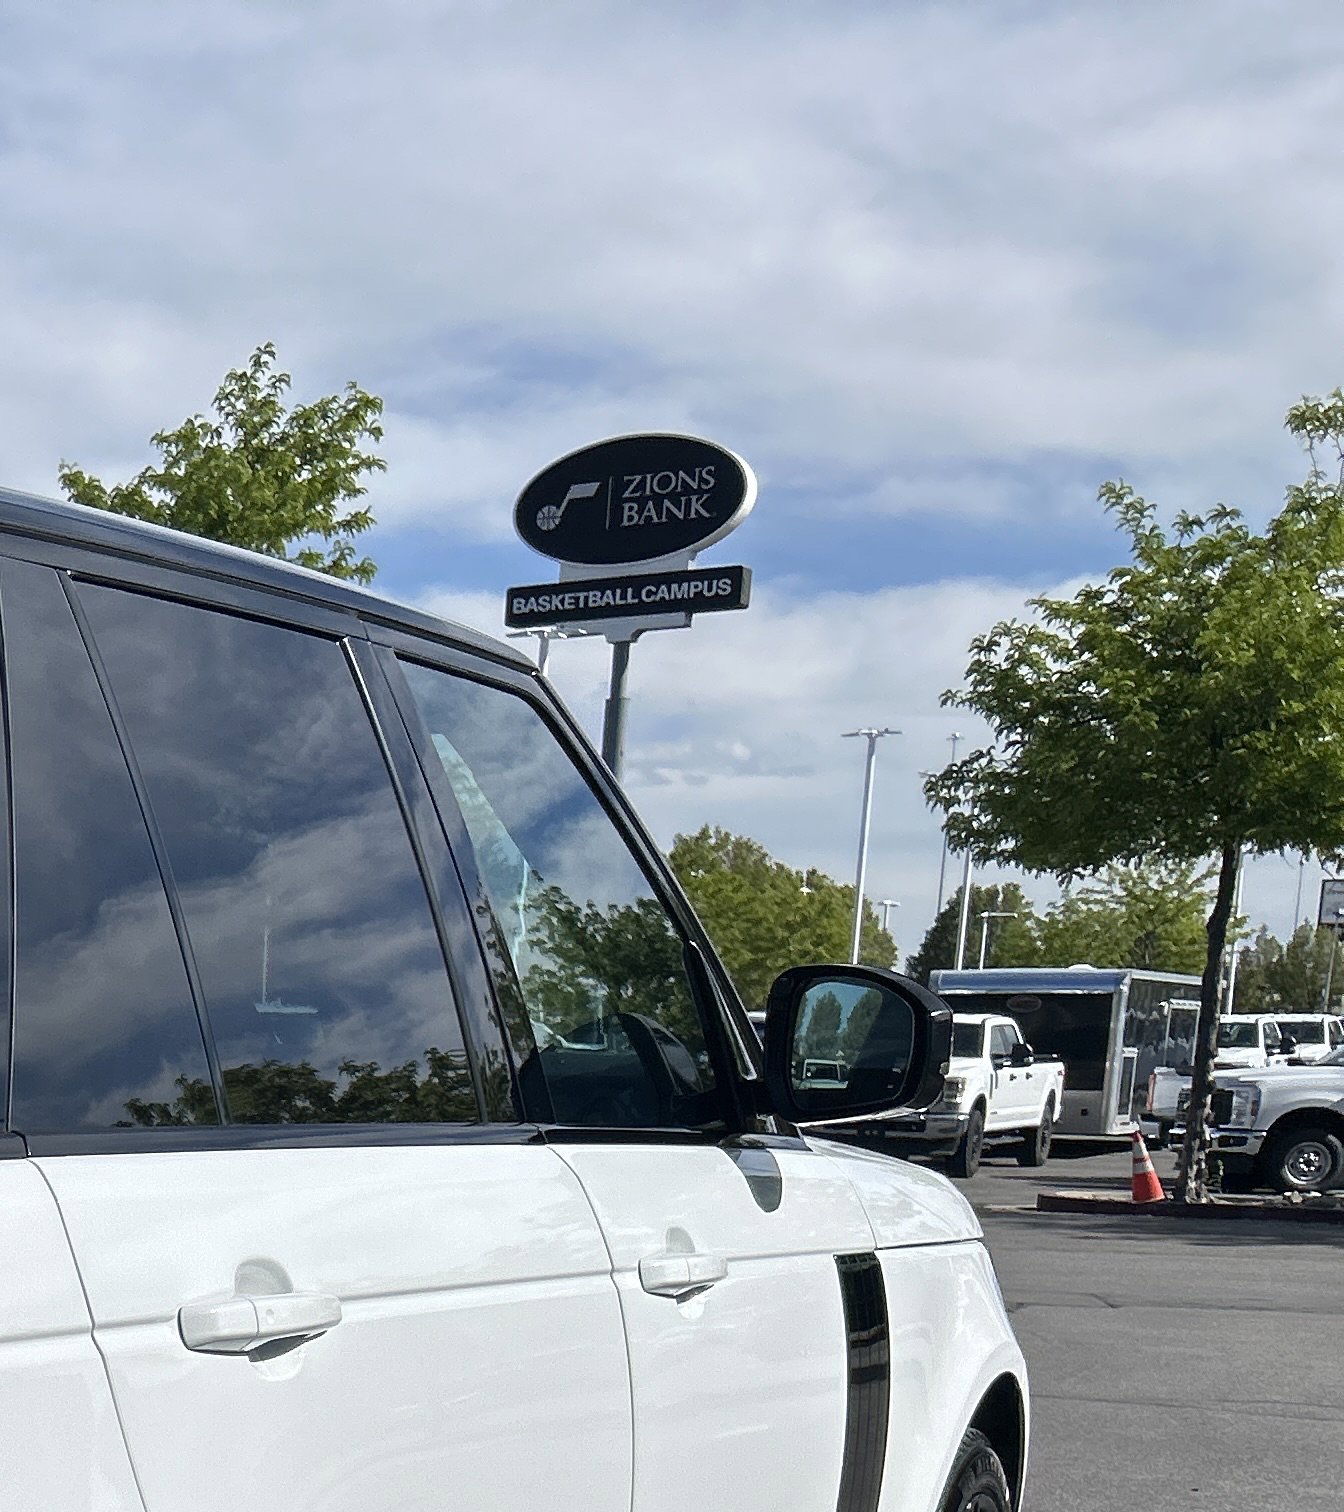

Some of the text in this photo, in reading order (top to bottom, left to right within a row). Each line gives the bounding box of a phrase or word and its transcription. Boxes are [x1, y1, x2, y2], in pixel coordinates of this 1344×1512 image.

[621, 465, 716, 499] ZIONS
[620, 493, 712, 528] BANK
[512, 577, 733, 615] BASKETBALL CAMPUS
